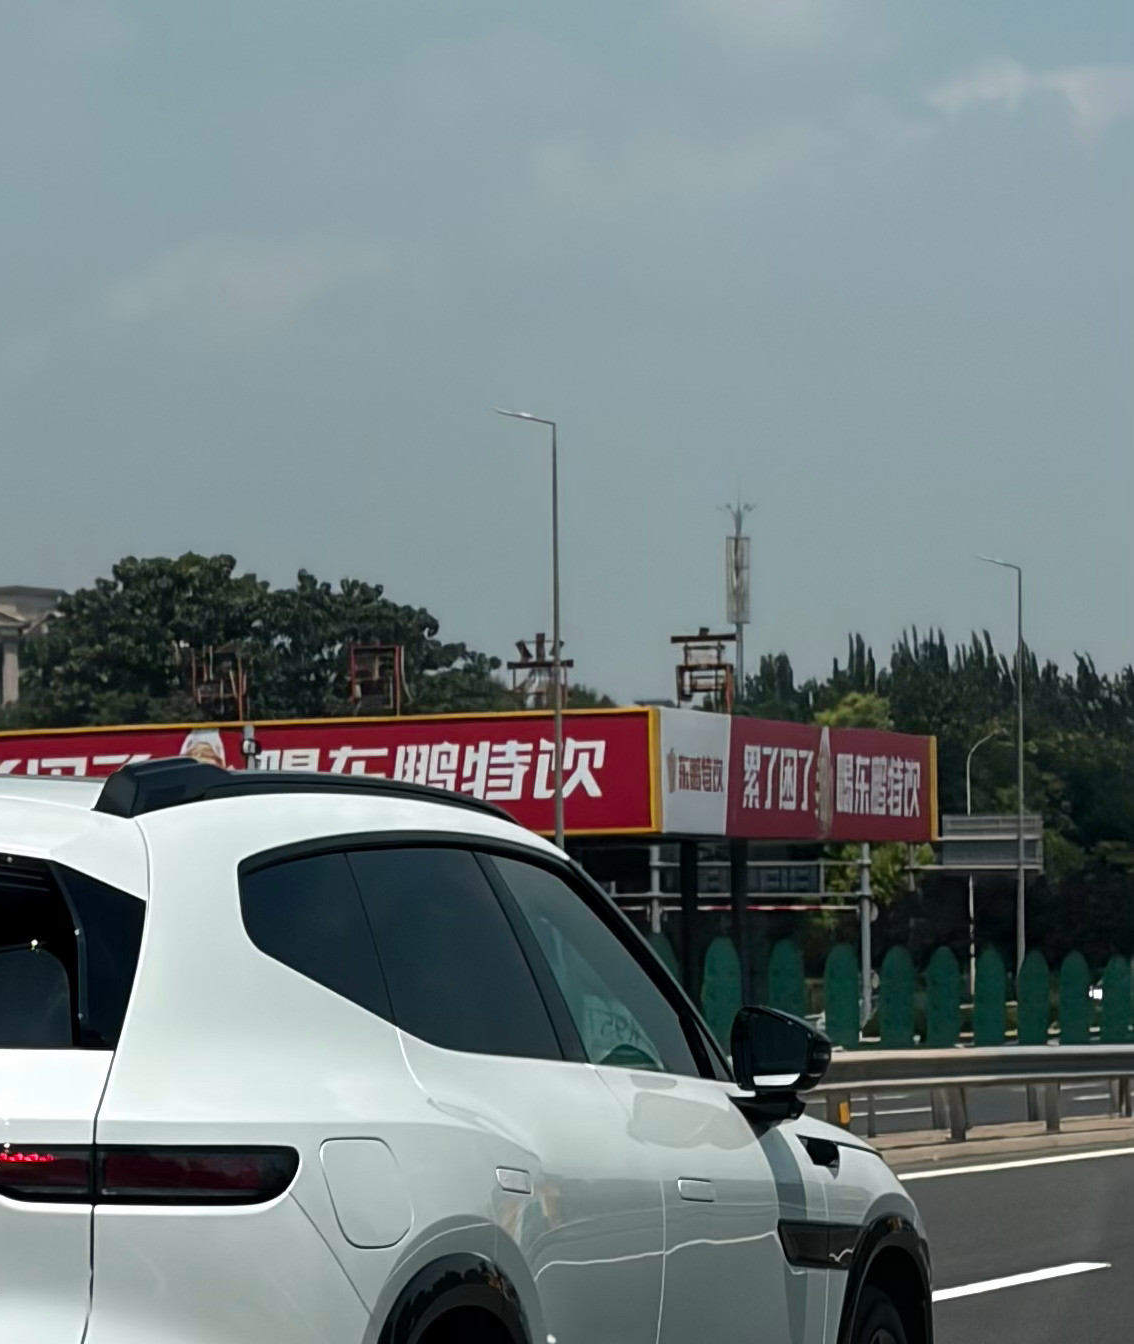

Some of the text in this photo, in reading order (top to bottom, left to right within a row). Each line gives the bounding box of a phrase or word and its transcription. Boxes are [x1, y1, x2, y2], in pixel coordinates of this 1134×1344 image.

[742, 744, 921, 818] 累了困了 喝东鹏特饮
